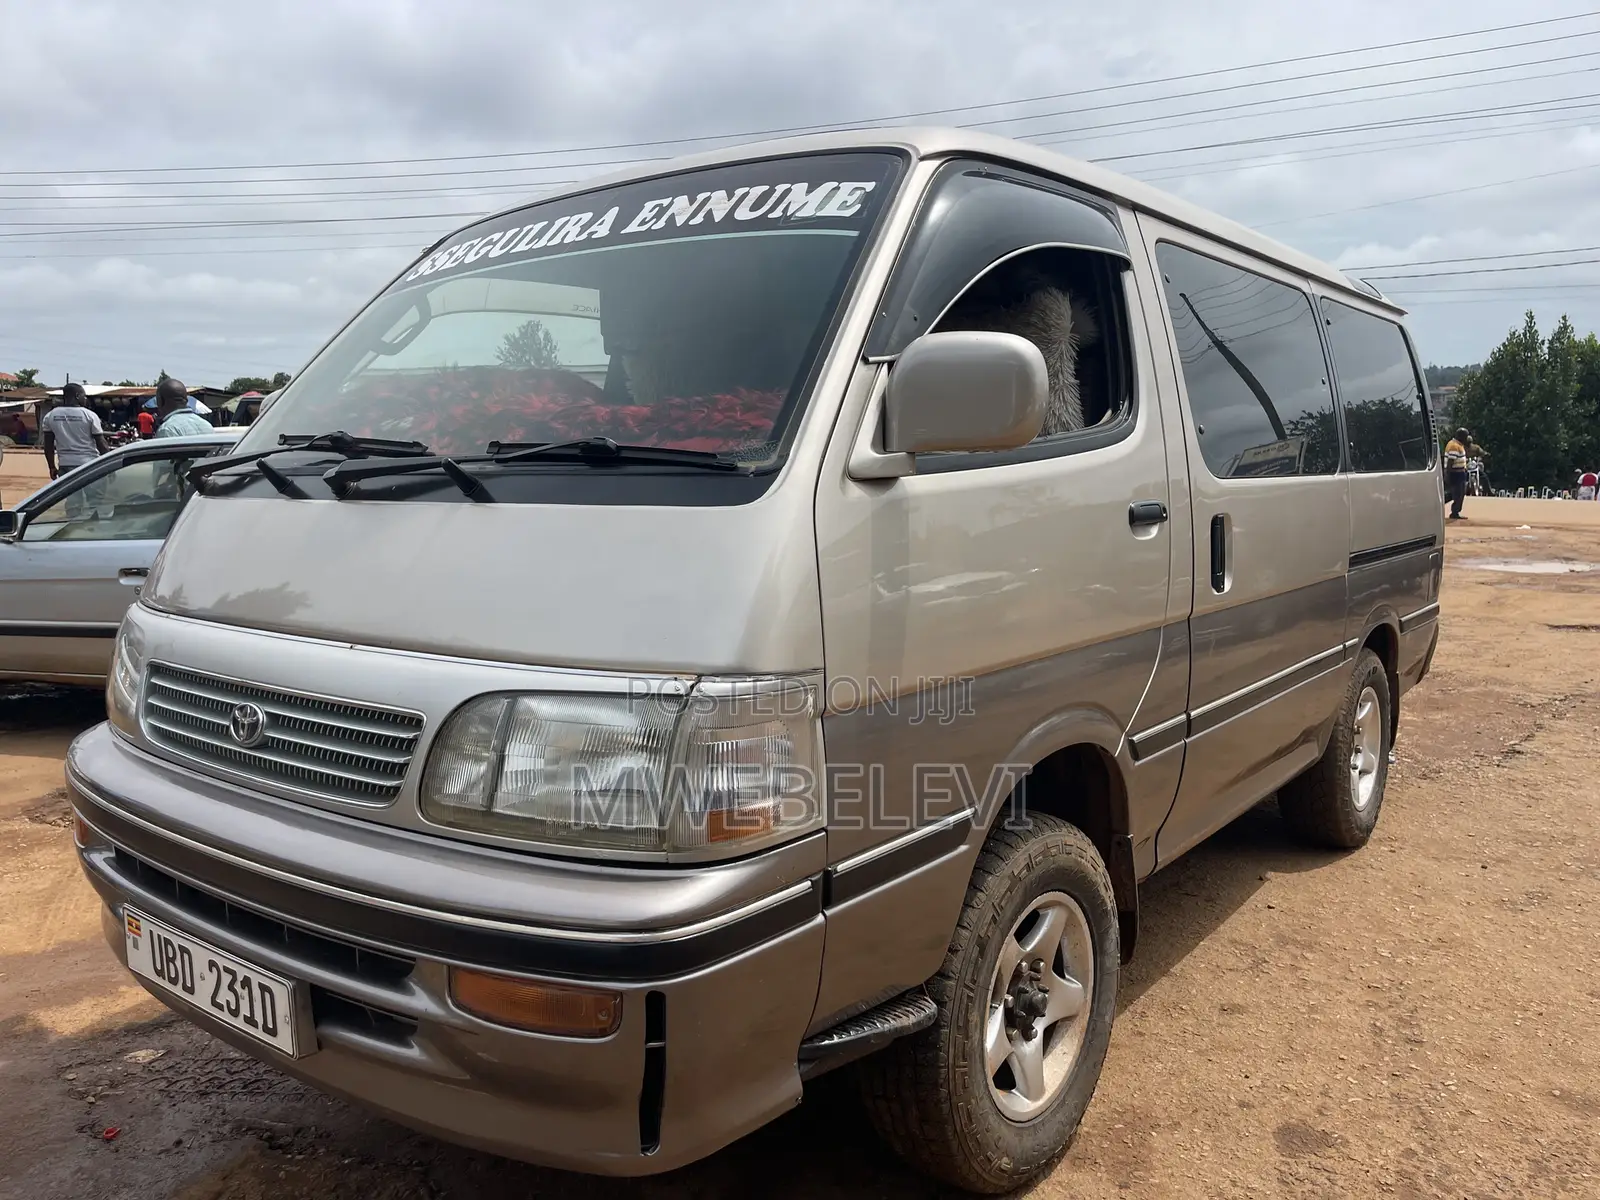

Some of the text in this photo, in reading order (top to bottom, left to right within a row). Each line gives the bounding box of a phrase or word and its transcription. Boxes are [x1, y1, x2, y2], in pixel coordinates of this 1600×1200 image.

[406, 181, 877, 282] SSEGULIRA ENNUME
[149, 929, 278, 1038] UBD 231D
